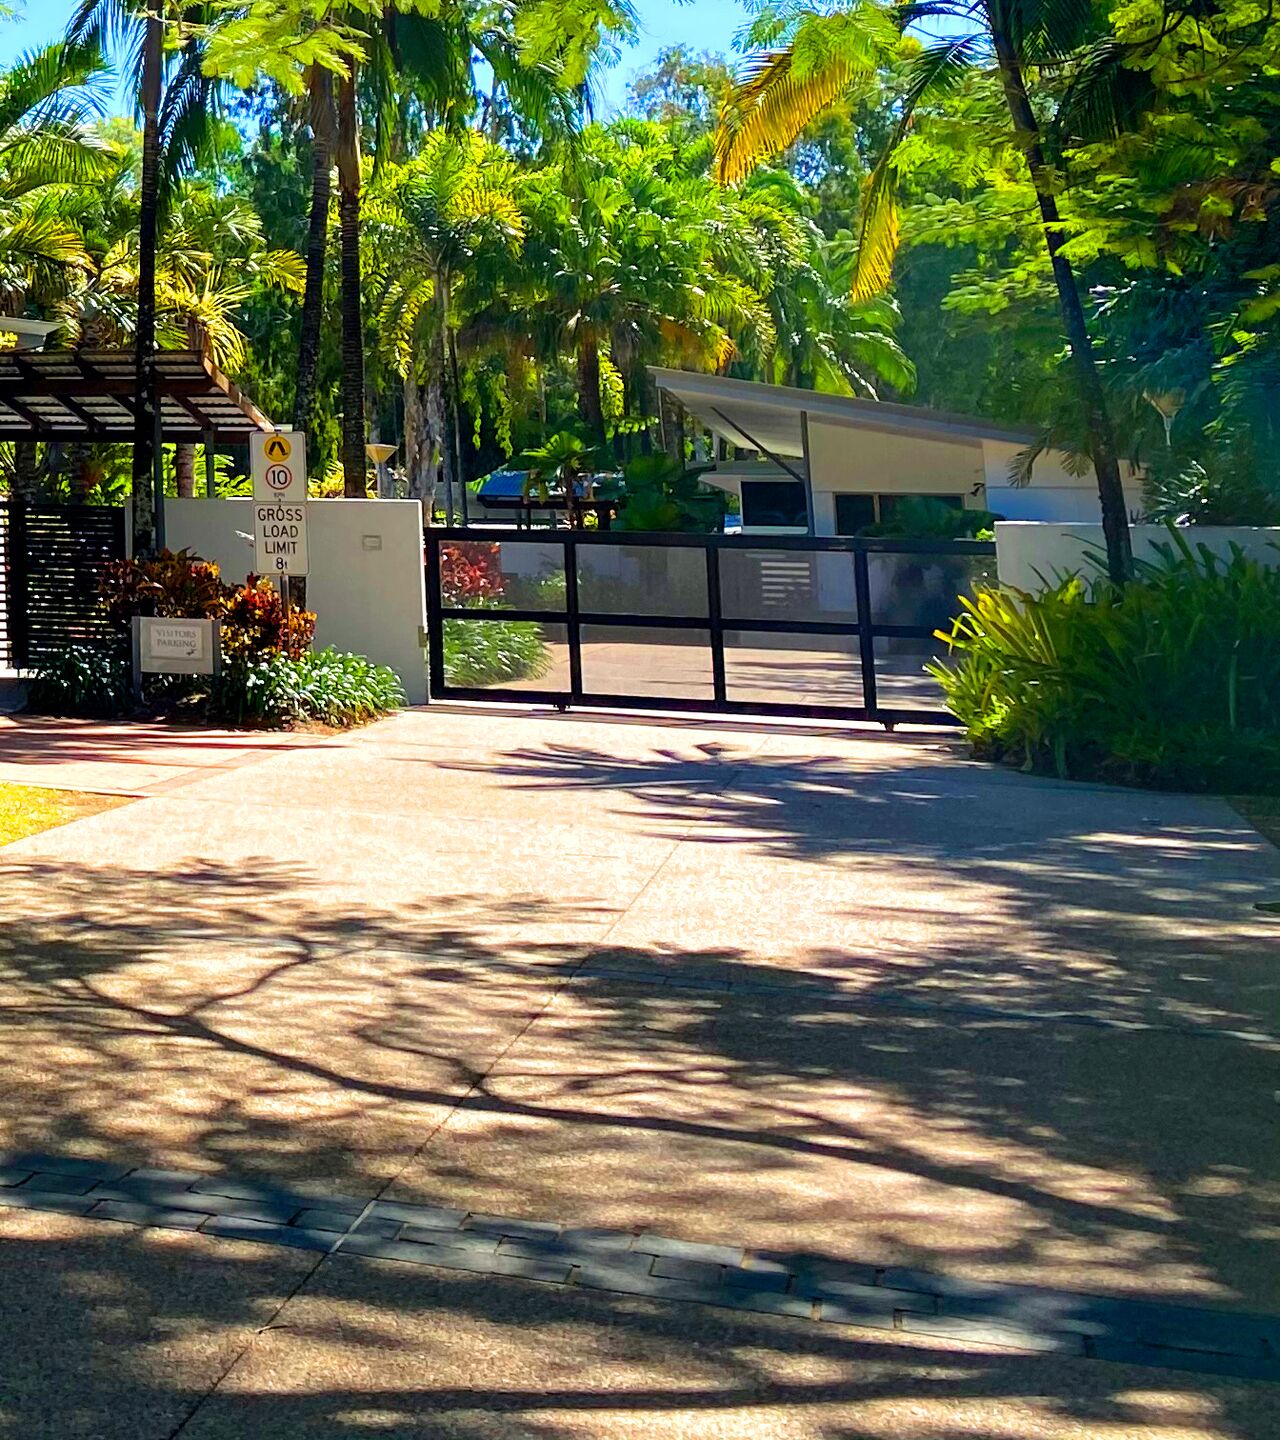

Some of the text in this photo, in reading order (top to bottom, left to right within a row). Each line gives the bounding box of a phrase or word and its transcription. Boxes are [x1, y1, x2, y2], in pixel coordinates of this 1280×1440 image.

[271, 469, 288, 486] 10
[257, 508, 303, 521] GROSS
[263, 525, 299, 538] LOAD
[265, 541, 298, 554] LIMIT
[156, 629, 197, 639] VISITORS
[156, 638, 197, 648] PARKING
